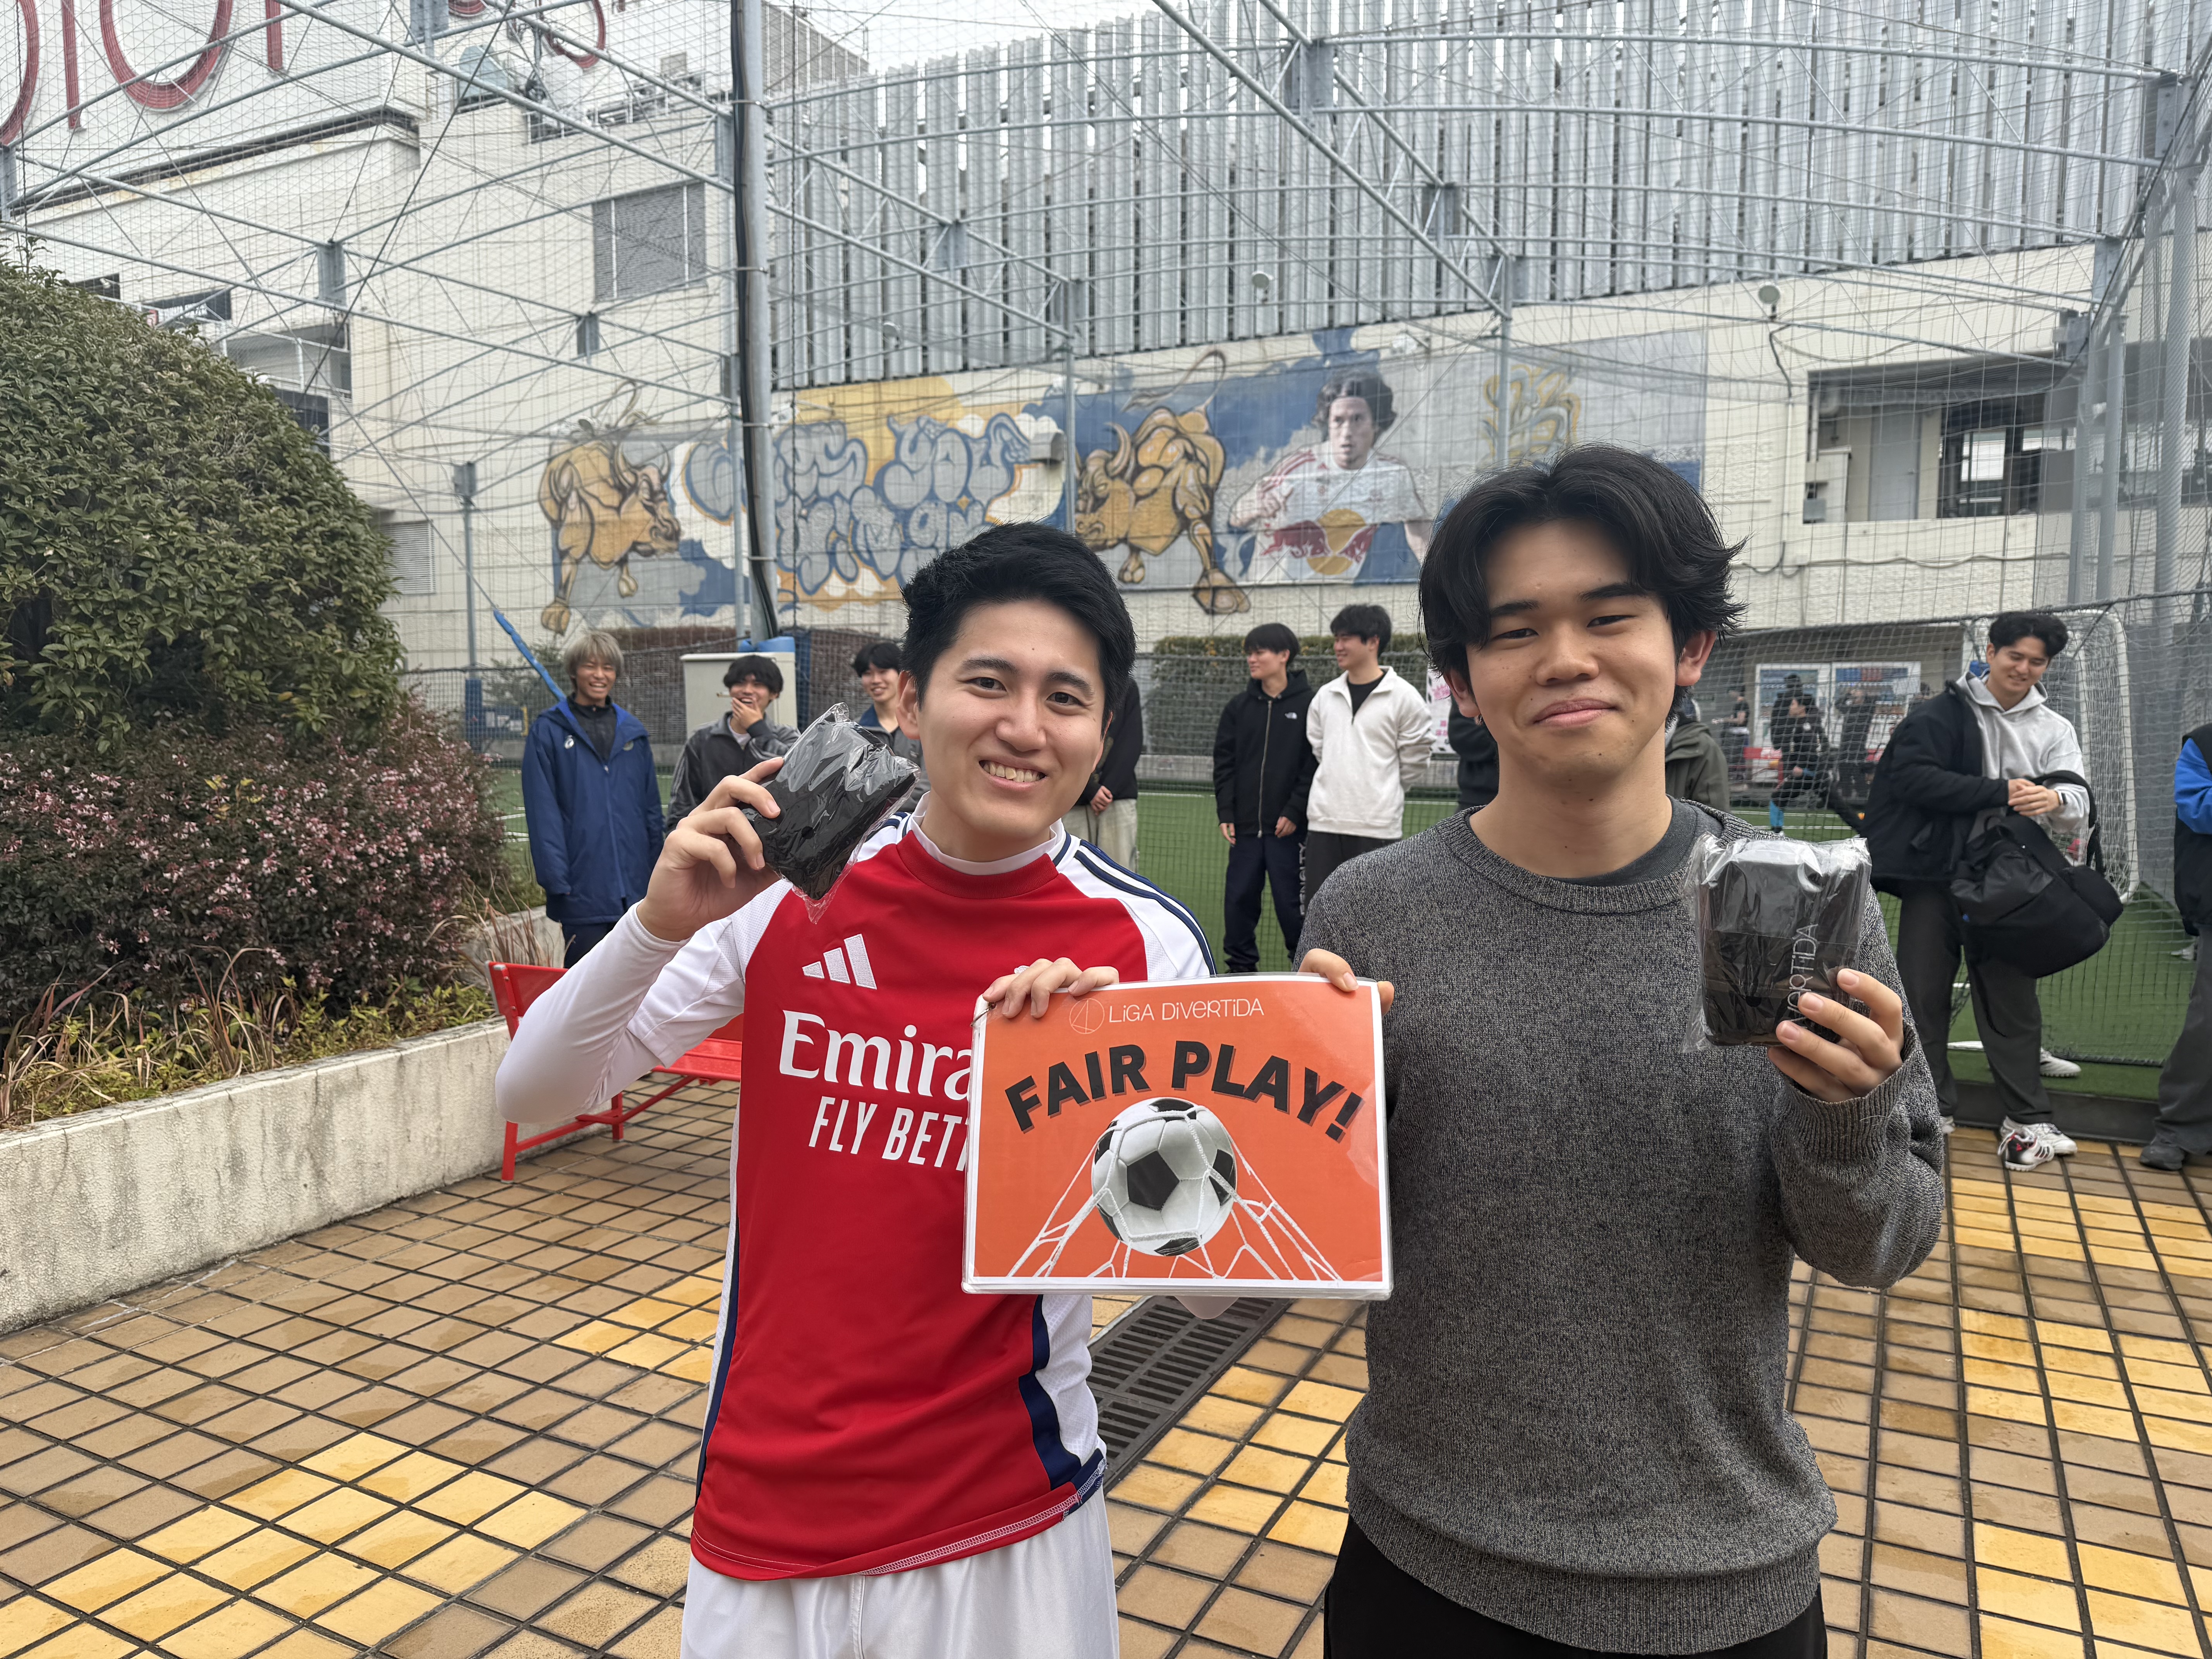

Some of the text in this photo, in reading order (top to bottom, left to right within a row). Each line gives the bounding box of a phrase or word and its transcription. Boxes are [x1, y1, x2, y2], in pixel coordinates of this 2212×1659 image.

[808, 1096, 878, 1155] FLY
[1005, 1040, 1365, 1144] FAIR PLAY!
